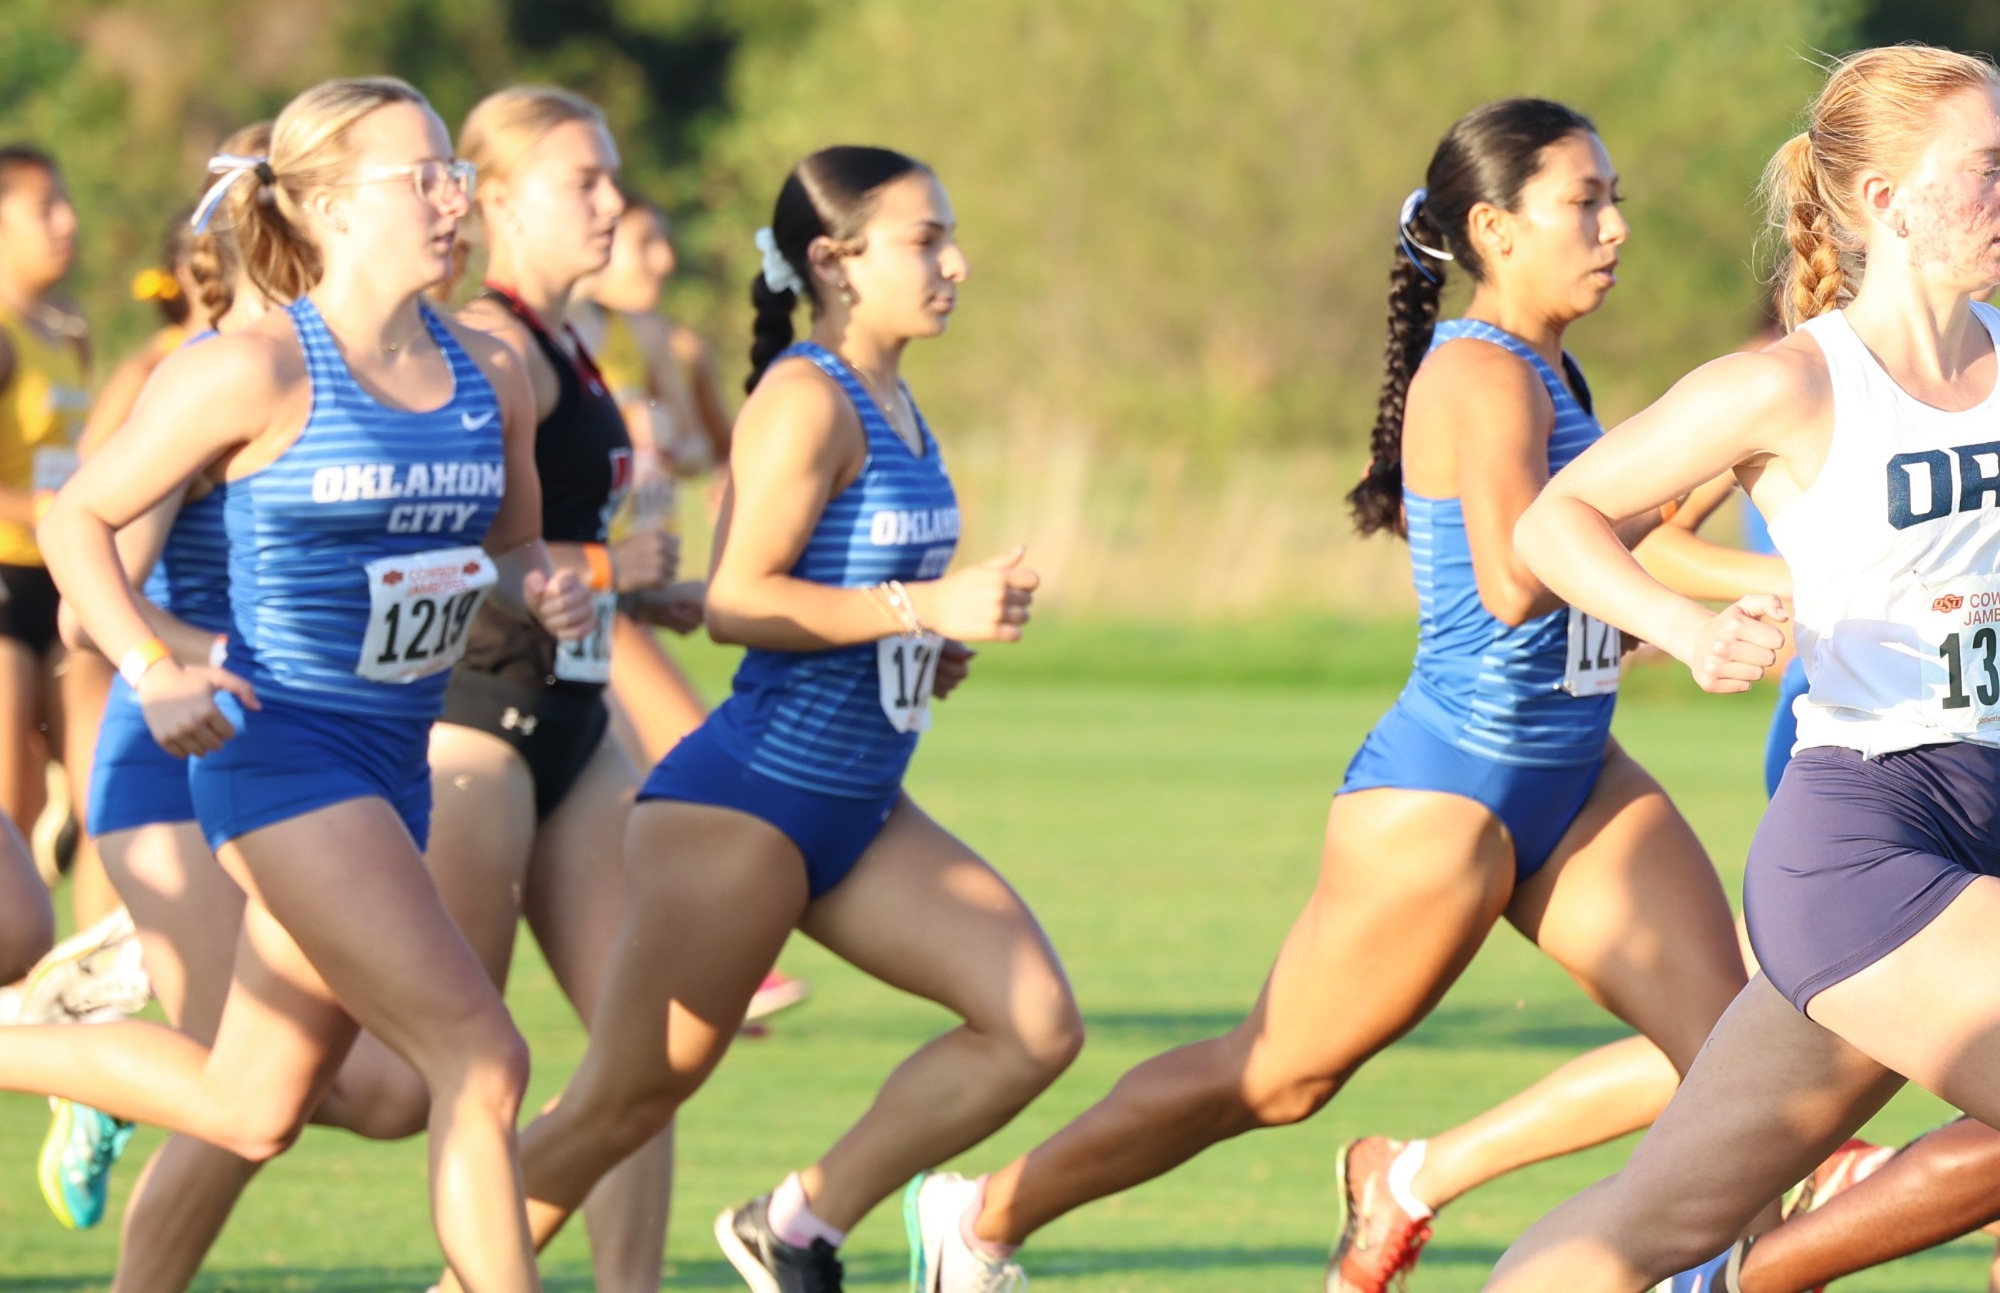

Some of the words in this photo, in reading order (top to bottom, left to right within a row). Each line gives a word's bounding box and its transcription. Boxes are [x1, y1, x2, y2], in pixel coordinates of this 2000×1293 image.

[387, 502, 479, 534] CITY
[377, 589, 480, 664] 1219
[1939, 627, 2000, 709] 13
